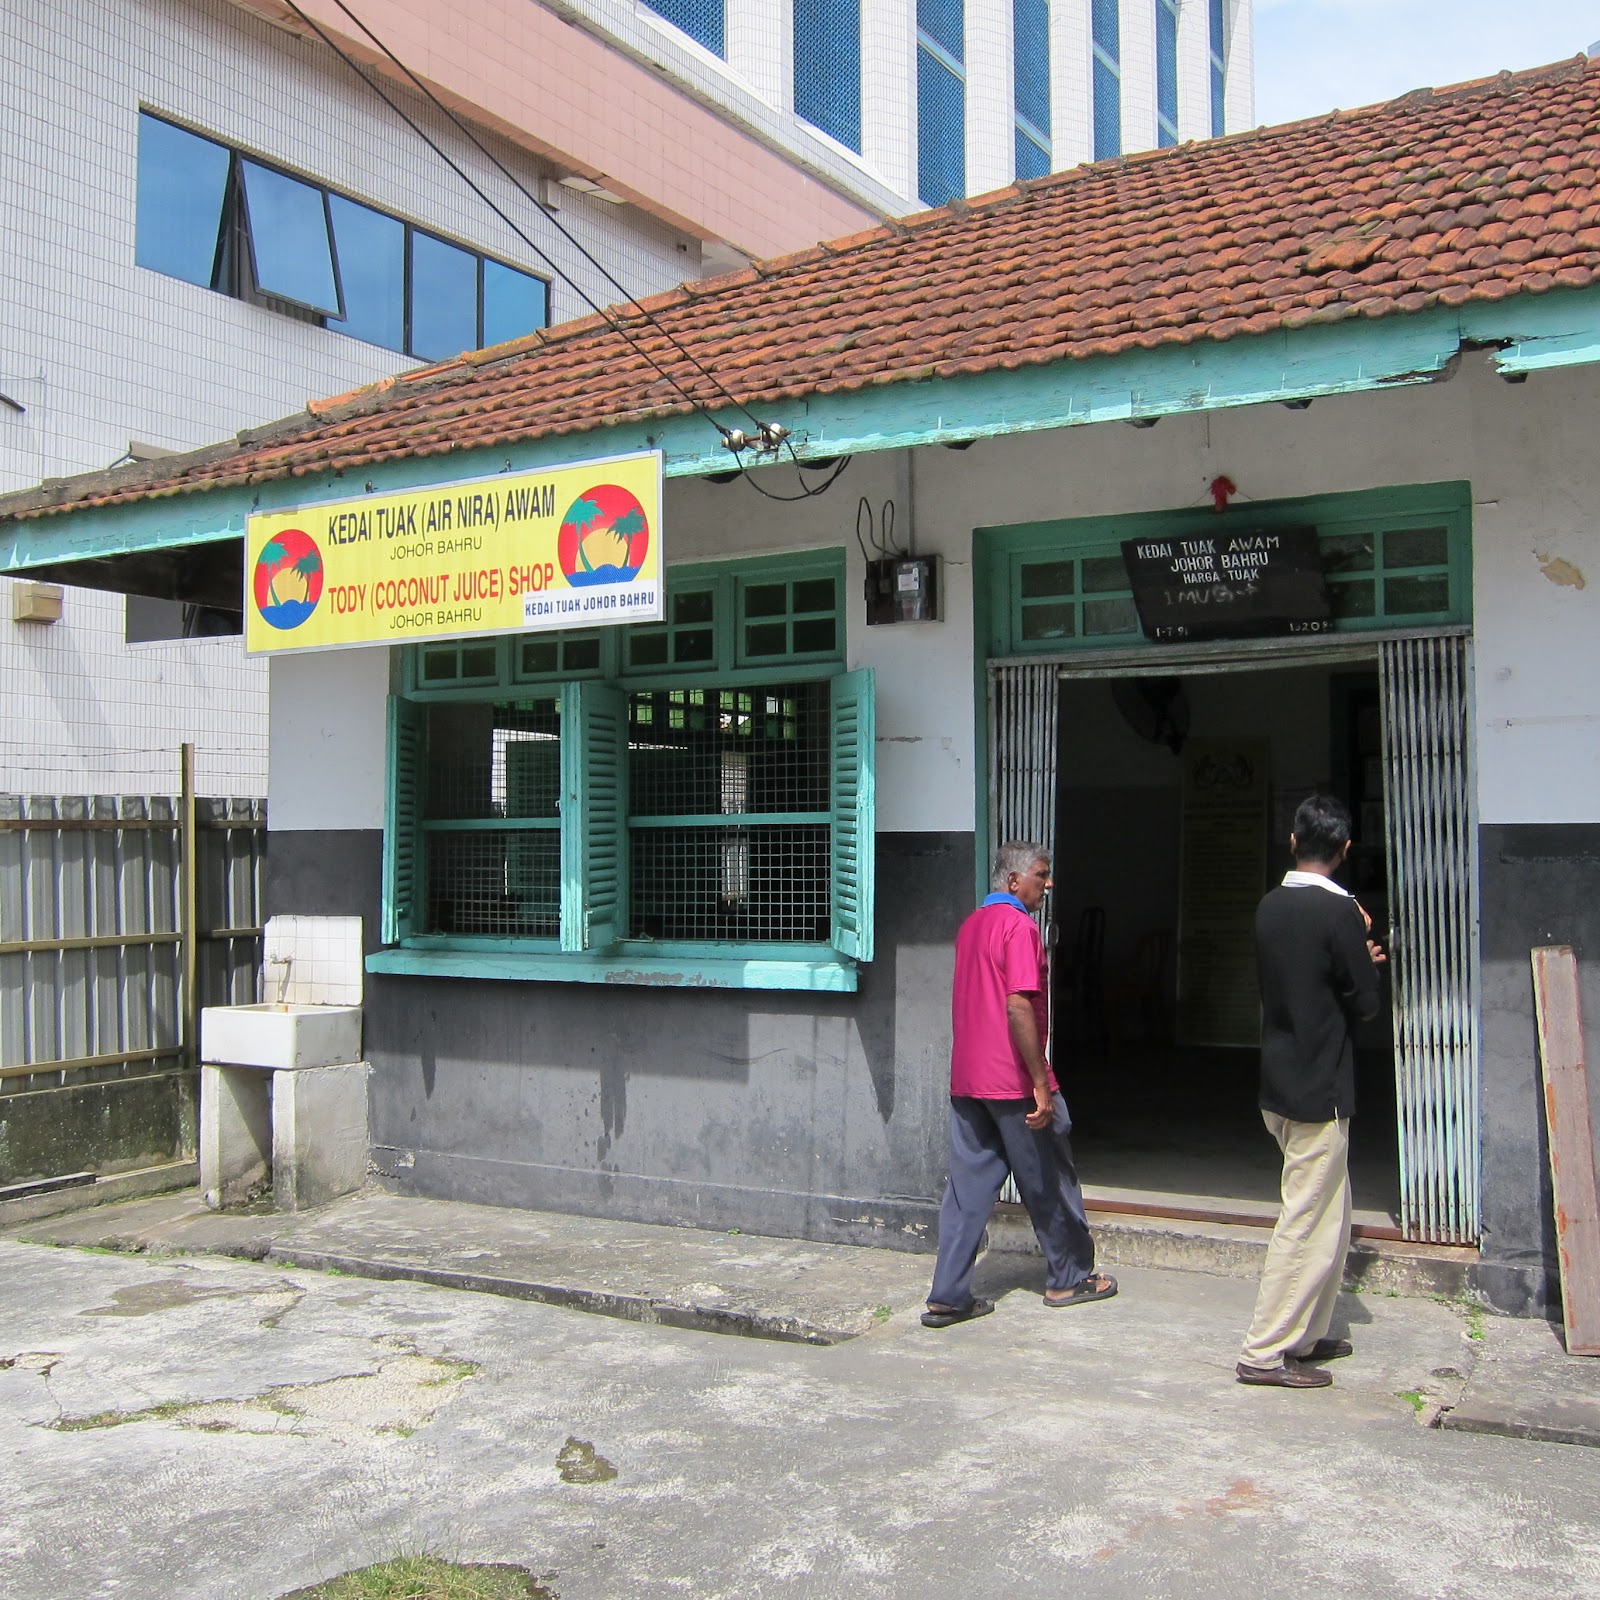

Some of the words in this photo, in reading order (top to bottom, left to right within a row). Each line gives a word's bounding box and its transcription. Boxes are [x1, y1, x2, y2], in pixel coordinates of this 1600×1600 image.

[328, 510, 372, 546] KEDAI
[376, 503, 417, 540] TUAK
[421, 499, 452, 542] (AIR
[457, 491, 500, 533] NIRA)
[504, 484, 555, 523] AWAM
[390, 542, 434, 560] JOHOR
[437, 536, 482, 555] BAHRU
[1137, 543, 1172, 559] KEDAI
[1180, 539, 1216, 555] TUAK
[1228, 536, 1280, 552] AWAM
[1170, 556, 1214, 573] JOHOR
[1222, 552, 1269, 569] BAHRU
[1183, 570, 1221, 584] HARGA
[1228, 568, 1260, 581] TUAK
[328, 583, 367, 614] TODY
[370, 574, 450, 617] (COCONUT
[453, 567, 504, 605] JUICE)
[508, 562, 554, 596] SHOP
[525, 601, 553, 616] KEDAI
[556, 598, 581, 613] TUAK
[583, 595, 617, 611] JOHOR
[620, 591, 655, 608] BAHRU
[389, 611, 433, 630] JOHOR
[437, 607, 482, 625] BAHRU
